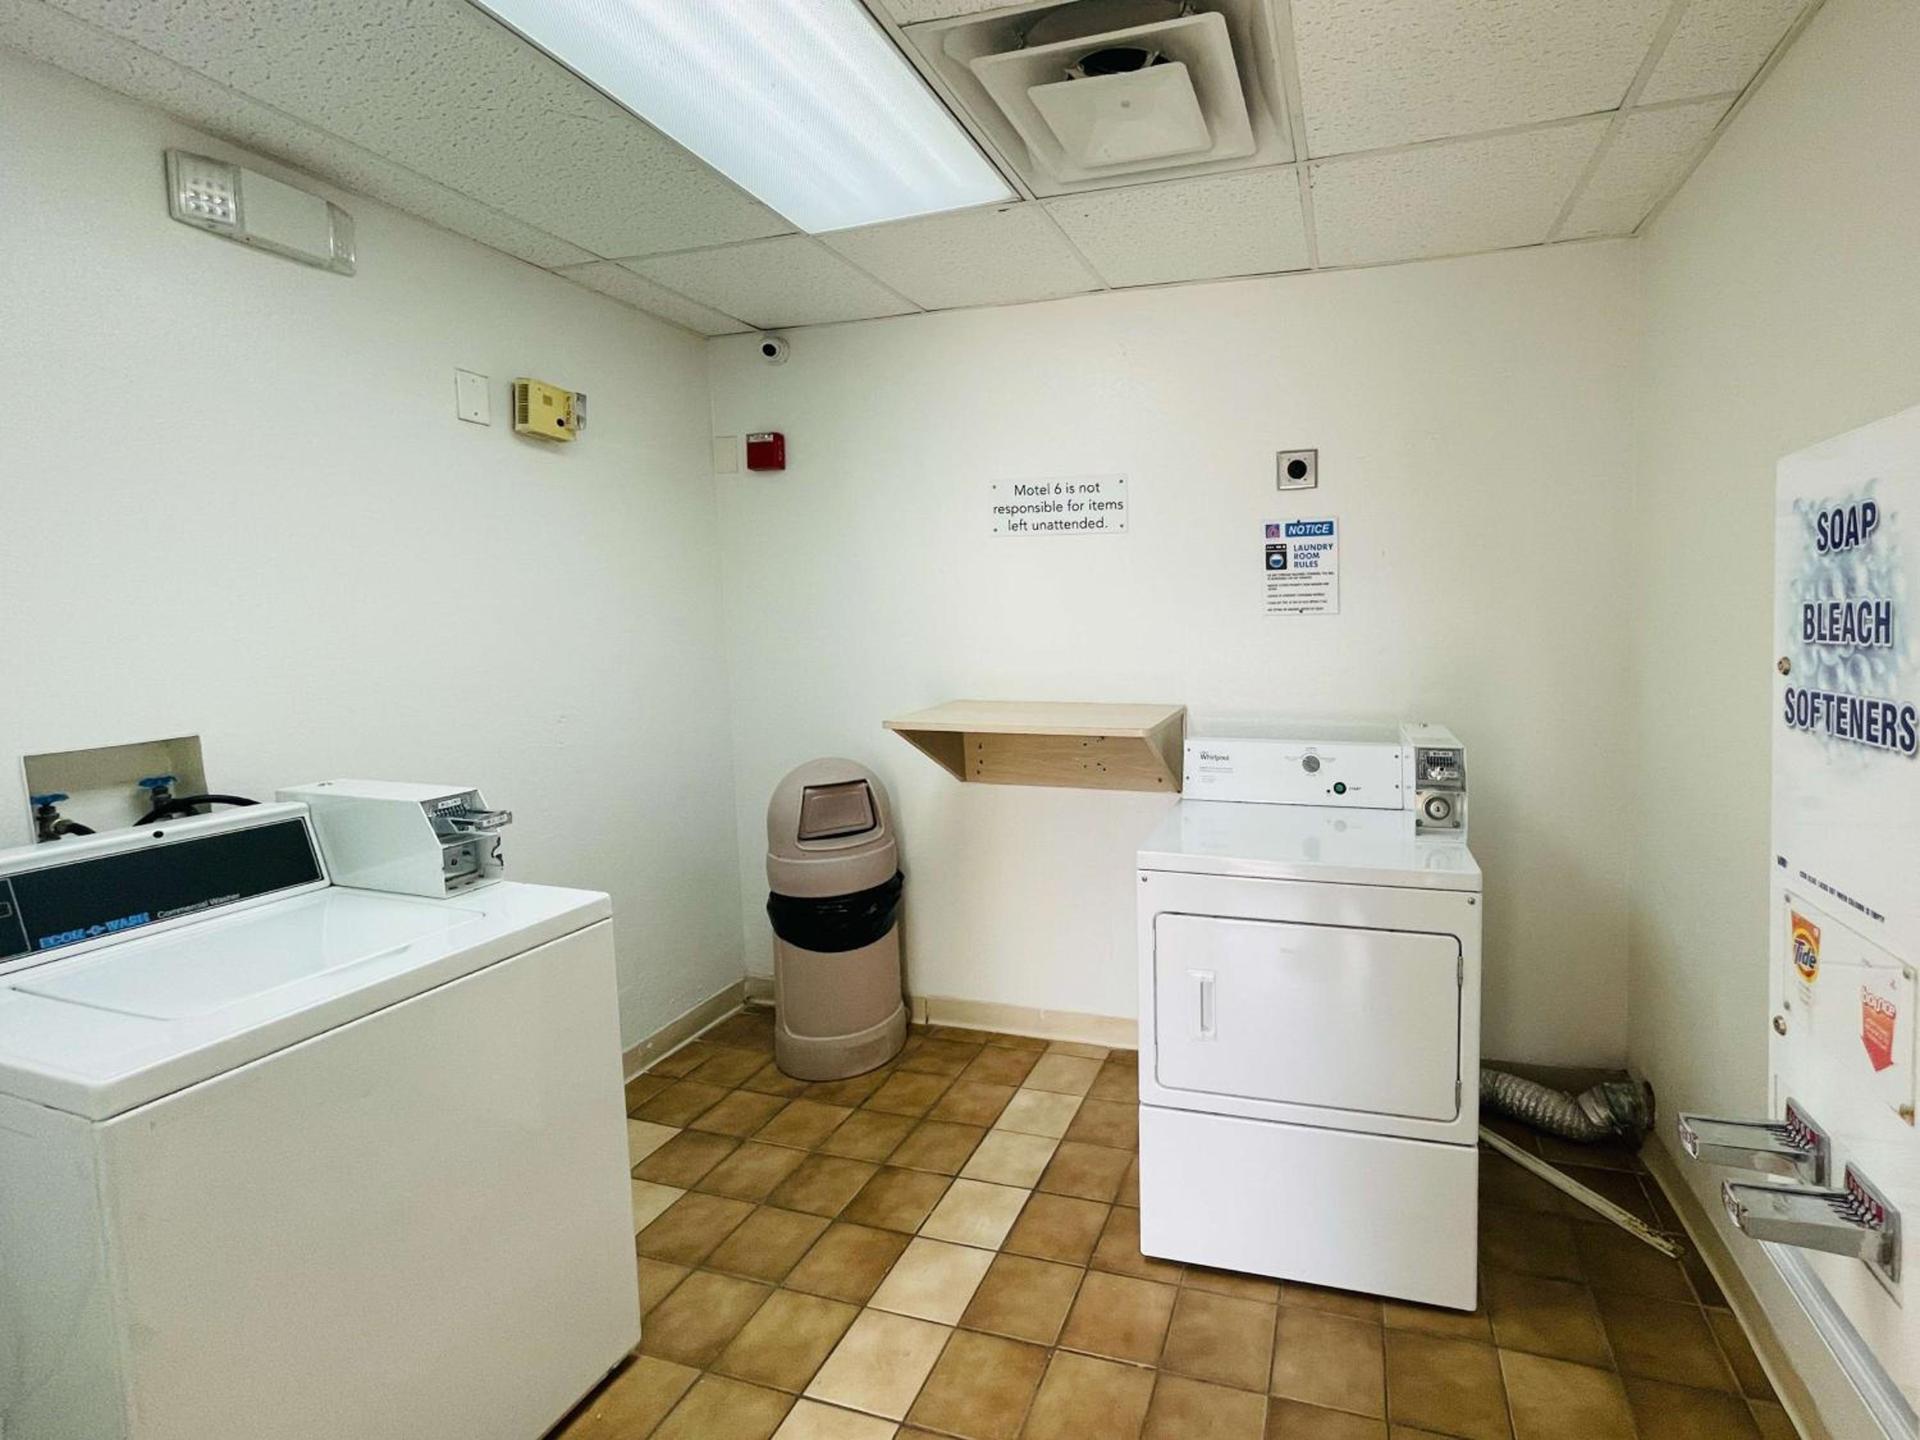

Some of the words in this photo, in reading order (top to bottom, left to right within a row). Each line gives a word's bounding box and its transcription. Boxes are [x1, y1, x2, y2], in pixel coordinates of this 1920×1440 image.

[1014, 483, 1051, 496] Motel
[1054, 483, 1062, 495] 6
[1065, 483, 1075, 494] is
[1079, 483, 1100, 493] not
[993, 500, 1063, 517] responsible
[1067, 499, 1084, 512] for
[1088, 499, 1124, 511] items
[1008, 518, 1028, 531] left
[1032, 516, 1109, 531] unattended.
[1288, 524, 1330, 535] NOTICE
[1816, 501, 1877, 551] SOAP
[1294, 552, 1320, 560] ROOM
[1294, 560, 1318, 568] RULES
[1802, 600, 1892, 646] BLEACH
[1784, 687, 1917, 754] SOFTENERS
[157, 899, 208, 919] Commercial
[209, 893, 241, 906] Washer
[1794, 938, 1818, 969] Tide
